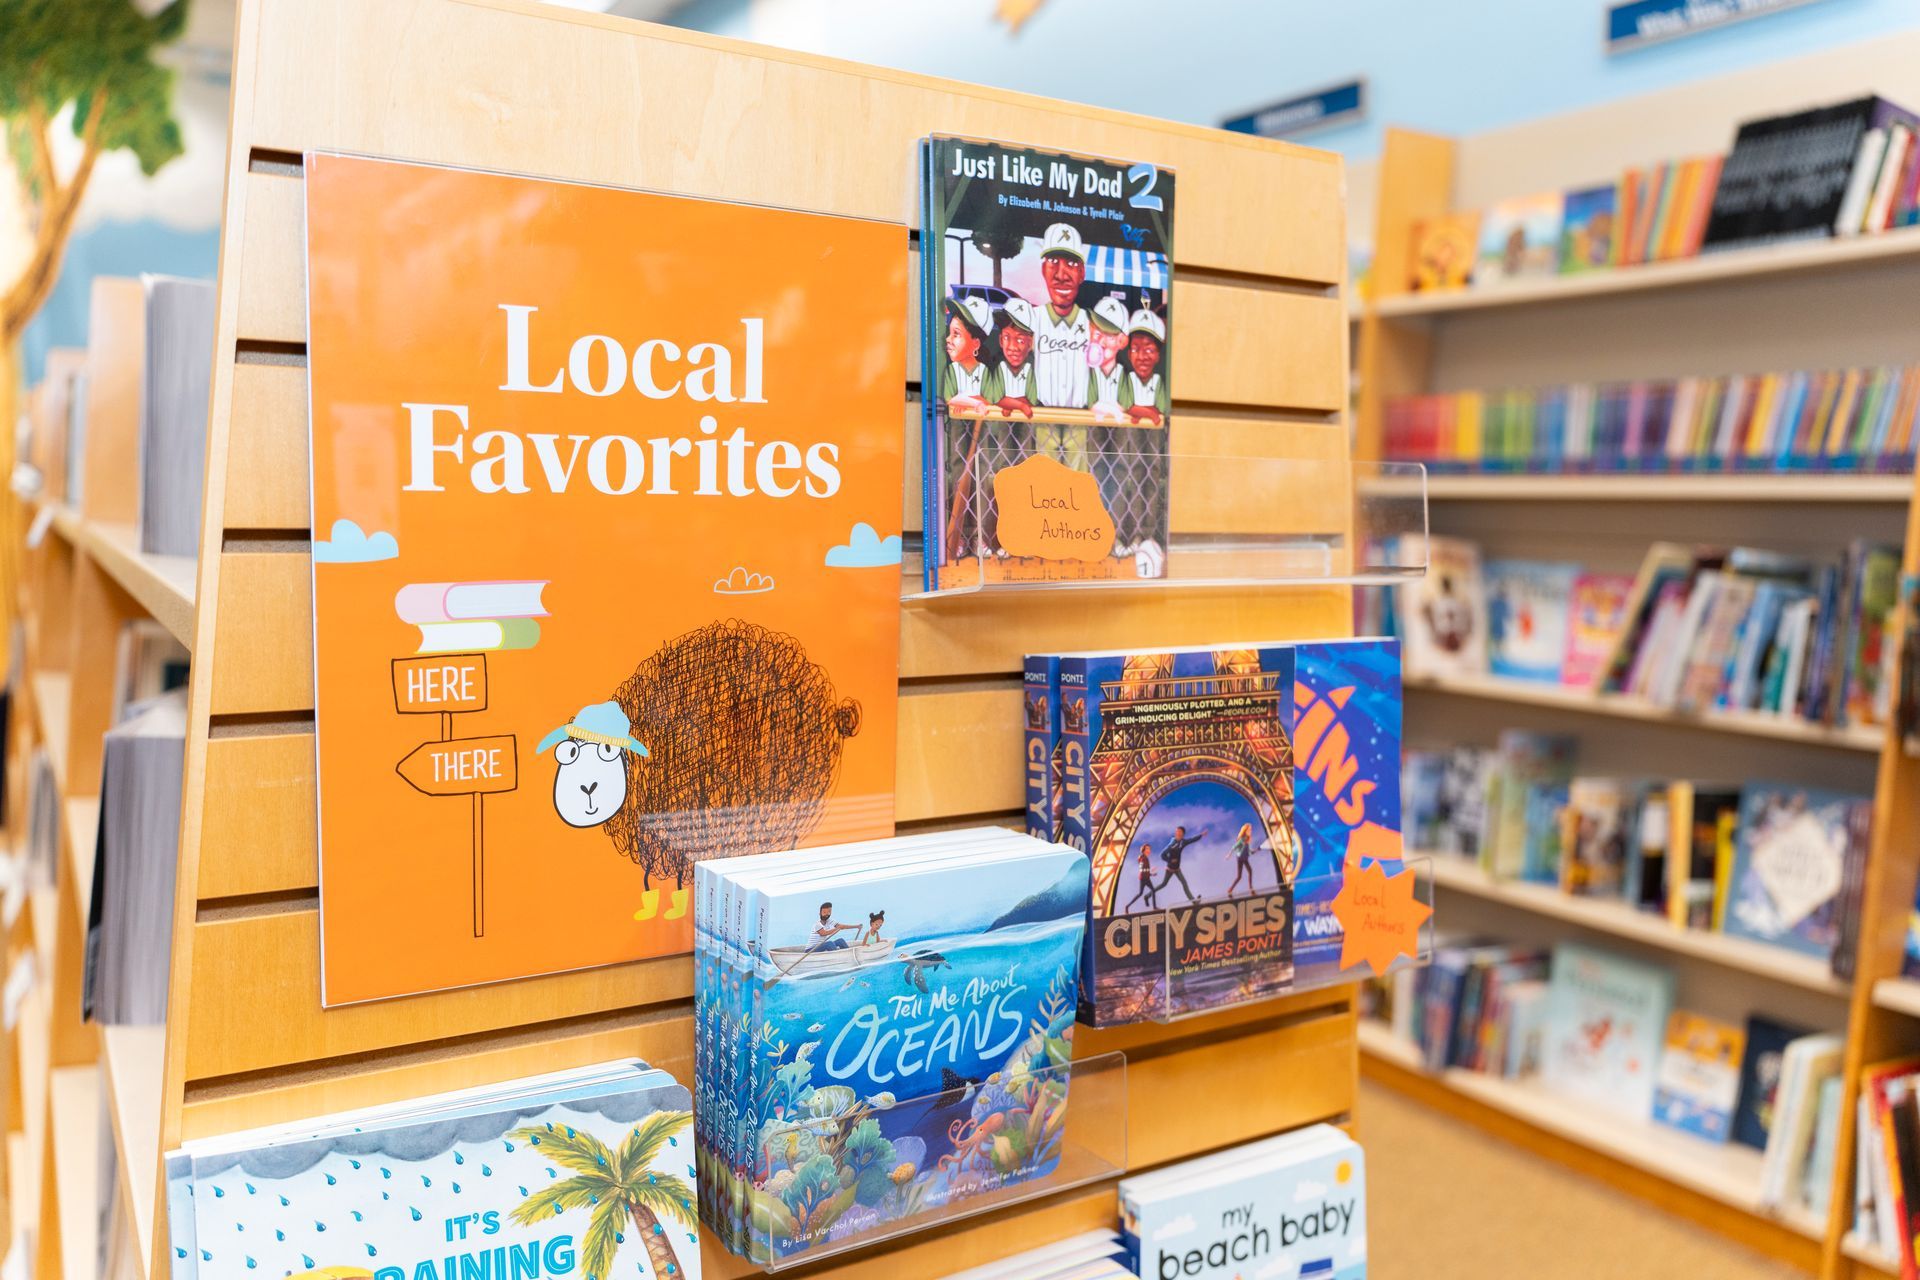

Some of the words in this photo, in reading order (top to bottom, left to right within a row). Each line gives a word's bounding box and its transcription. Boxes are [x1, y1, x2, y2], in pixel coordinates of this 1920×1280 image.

[952, 149, 996, 180] Just
[1002, 155, 1043, 186] Like
[1049, 162, 1079, 198] My
[1084, 167, 1123, 198] Dad
[1127, 163, 1163, 211] 2
[998, 194, 1008, 207] By
[1009, 195, 1041, 209] Elizabeth
[1043, 200, 1051, 211] M.
[1053, 202, 1081, 215] Johnson
[1082, 206, 1088, 216] &
[1089, 207, 1107, 219] Tyrell
[1108, 210, 1124, 221] Plair
[497, 304, 769, 404] Local
[1038, 335, 1088, 354] Coach
[401, 402, 842, 499] Favorites
[1030, 485, 1080, 511] Local
[1040, 519, 1101, 541] Authors
[407, 666, 476, 703] HERE
[1025, 672, 1047, 682] PONTI
[1061, 673, 1084, 684] PONTI
[1228, 698, 1244, 706] AND
[1245, 697, 1251, 705] A
[1115, 714, 1177, 726] GRIN-INDUCING
[431, 748, 502, 782] THERE
[1294, 680, 1377, 826] INS
[1028, 737, 1048, 824] CITY
[1065, 740, 1087, 829] CITY
[1354, 884, 1386, 909] Local
[1104, 909, 1192, 959] CITY
[1195, 895, 1286, 945] SPIES
[1304, 914, 1344, 937] WAYN
[1362, 913, 1405, 935] Authors
[1180, 942, 1233, 965] JAMES
[1236, 934, 1283, 953] PONTI
[1184, 963, 1199, 973] York
[1201, 959, 1220, 970] Times
[1222, 953, 1258, 967] Bestselling
[1259, 950, 1281, 960] Author
[888, 994, 922, 1020] Tell
[929, 986, 960, 1017] Me
[962, 962, 1021, 1008] About
[752, 1031, 760, 1050] Tell
[825, 985, 1027, 1084] OCEANS
[750, 1050, 758, 1068] Me
[968, 1182, 977, 1191] by
[445, 1210, 500, 1242] IT'S
[1222, 1202, 1254, 1228] my
[782, 1239, 793, 1248] By
[795, 1232, 812, 1244] Lisa
[815, 1220, 847, 1238] Varchol
[849, 1213, 876, 1226] Perron
[1158, 1223, 1270, 1280] beach
[1280, 1199, 1355, 1247] baby
